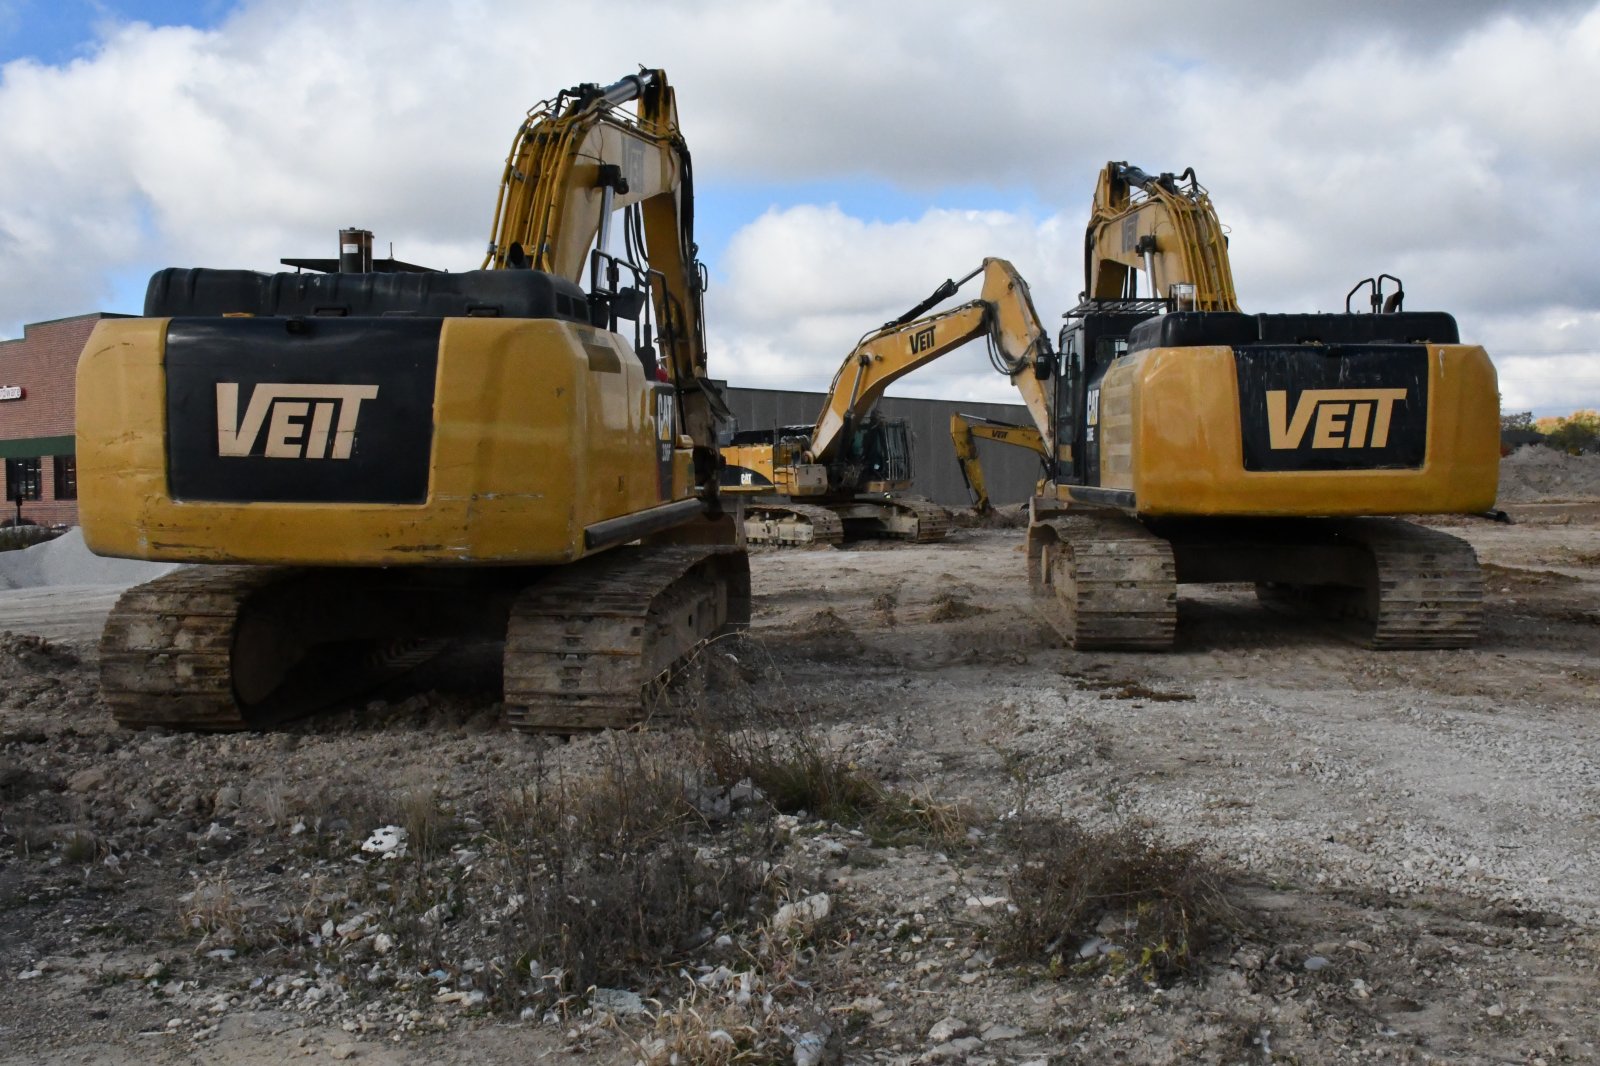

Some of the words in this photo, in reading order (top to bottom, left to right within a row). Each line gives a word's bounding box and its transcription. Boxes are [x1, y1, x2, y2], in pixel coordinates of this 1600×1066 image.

[909, 324, 936, 355] VEIT
[216, 382, 379, 459] VEIT
[657, 393, 672, 441] CAT
[1087, 389, 1099, 425] CAT
[1266, 388, 1407, 449] VEIT
[740, 473, 752, 485] CAT
